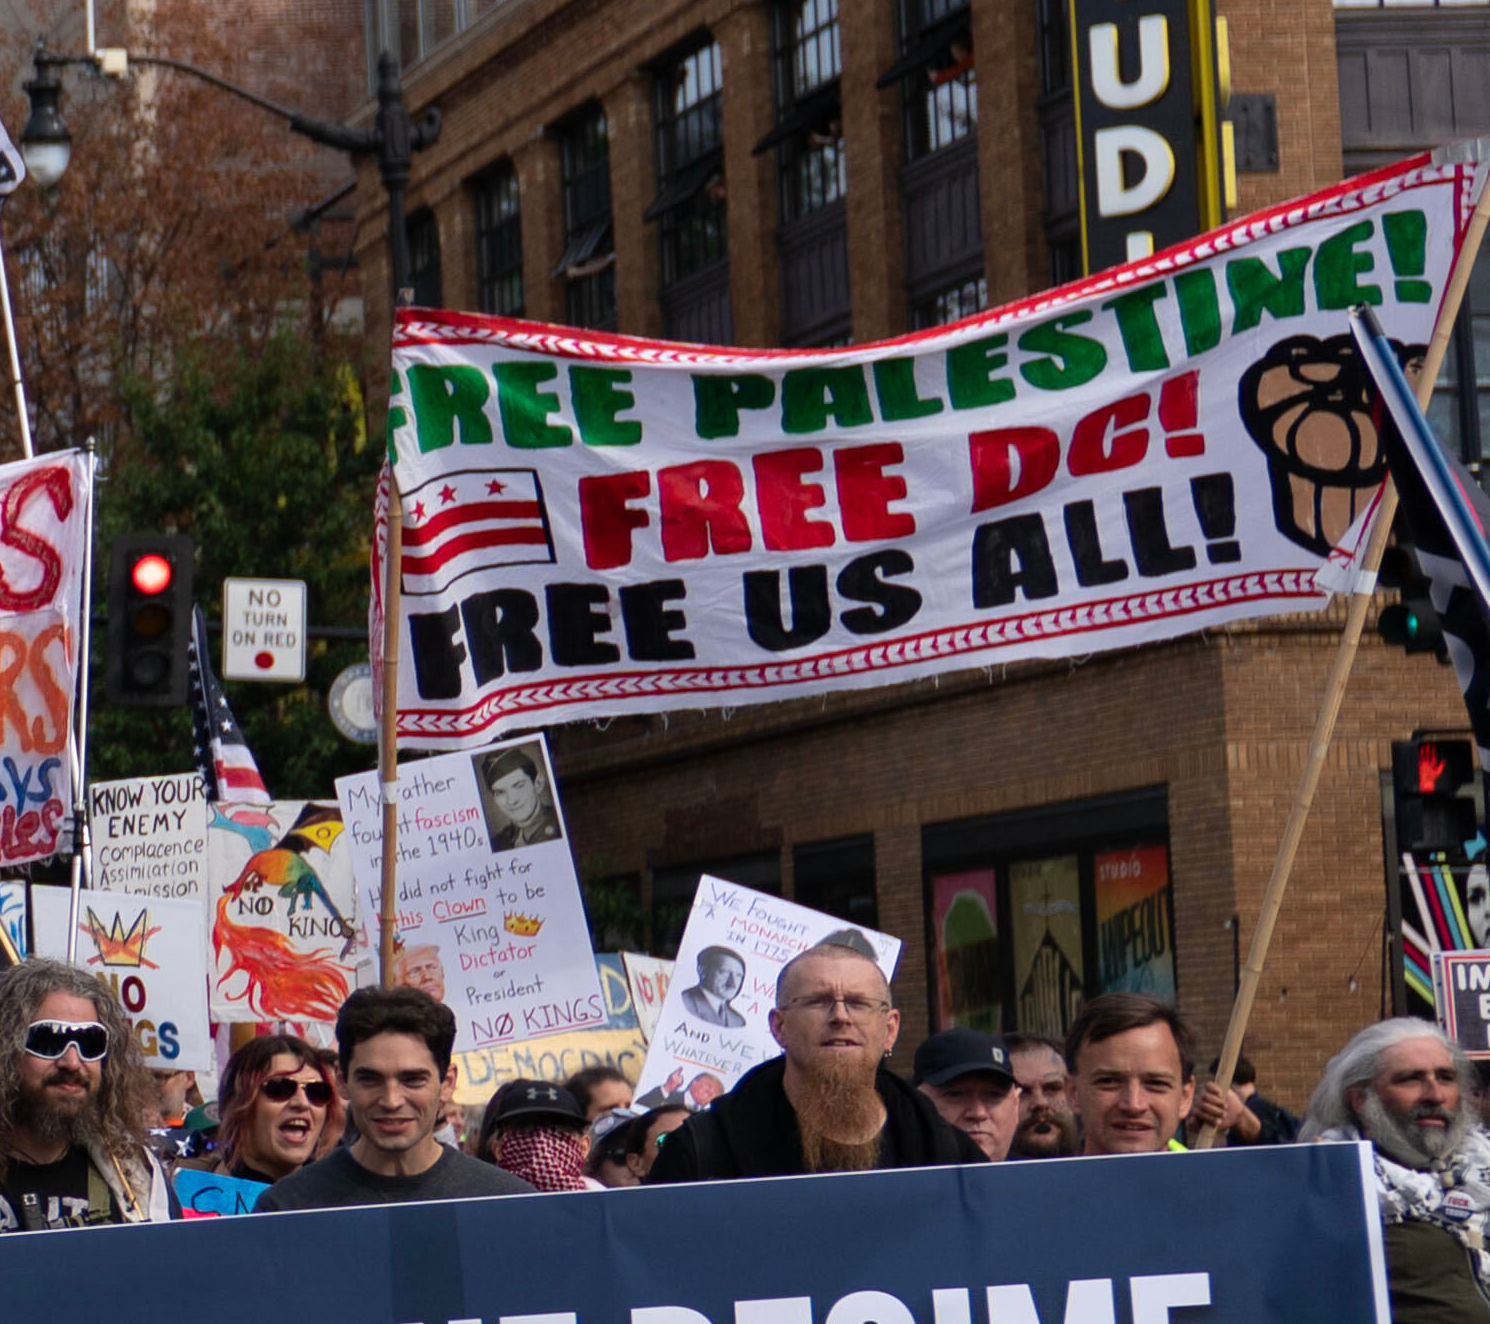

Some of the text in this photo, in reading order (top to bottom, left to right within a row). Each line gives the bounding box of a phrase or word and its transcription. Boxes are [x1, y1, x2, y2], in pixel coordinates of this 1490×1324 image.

[694, 209, 1433, 439] PALESTINE!
[578, 370, 1206, 570] FREE DC!
[249, 589, 282, 607] NO
[409, 472, 1241, 701] FREE US ALL!
[243, 611, 288, 627] TURN
[232, 630, 297, 647] ON RED
[91, 775, 208, 818] KNOW YOUR
[348, 785, 383, 817] My
[107, 807, 188, 839] ENEMY
[414, 805, 481, 832] fascism
[98, 859, 200, 888] Assimilation
[398, 858, 534, 903] did not fight for
[1099, 860, 1142, 882] STUDIO
[432, 897, 487, 921] Clown
[496, 889, 518, 905] to
[526, 880, 547, 899] be
[704, 906, 716, 921] A
[238, 895, 356, 941] NO KINGS
[747, 897, 809, 937] FOUGHT
[454, 923, 501, 948] King
[725, 929, 789, 961] IN 1775
[459, 942, 537, 972] Dictator
[493, 969, 506, 979] or
[465, 976, 545, 1007] President
[523, 993, 605, 1030] KINGS
[663, 1035, 743, 1076] WHATEVER
[718, 1035, 756, 1058] WE
